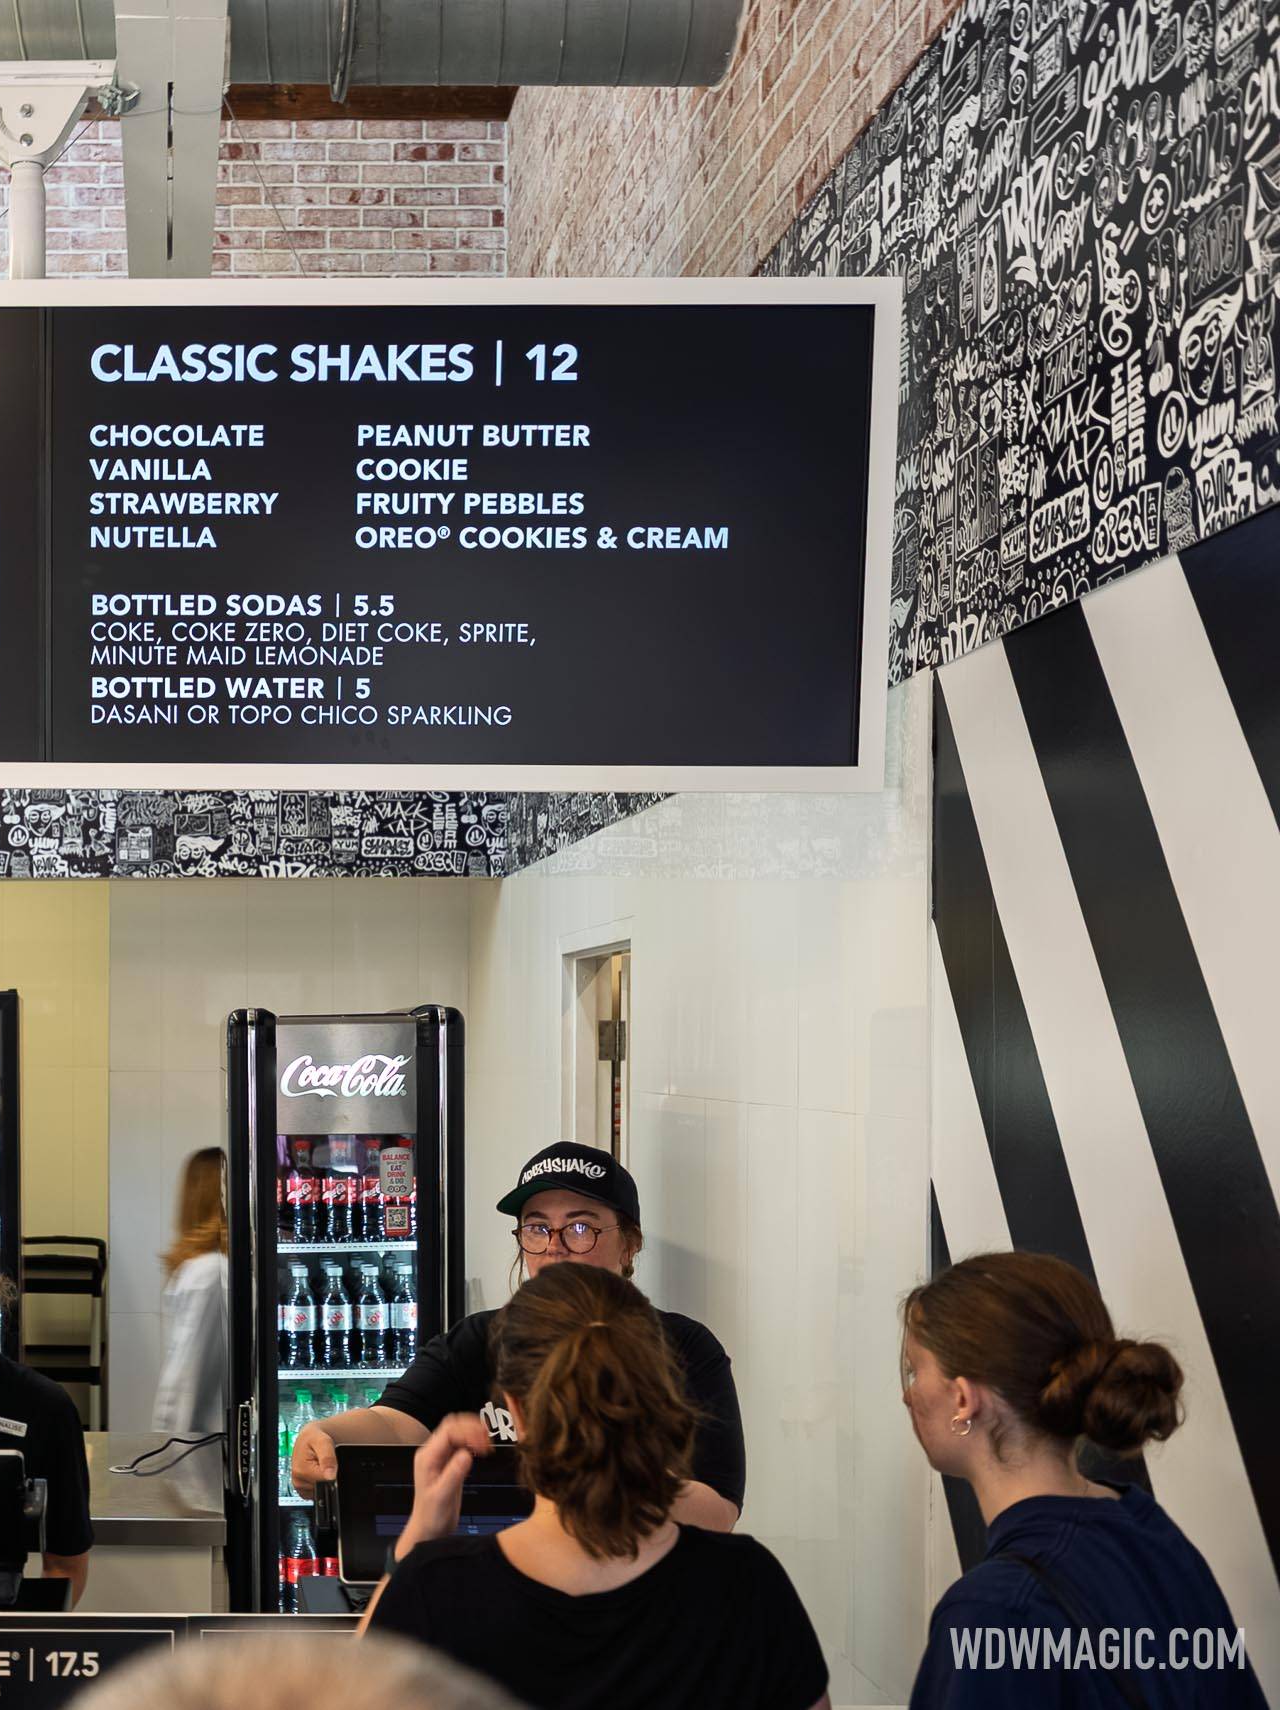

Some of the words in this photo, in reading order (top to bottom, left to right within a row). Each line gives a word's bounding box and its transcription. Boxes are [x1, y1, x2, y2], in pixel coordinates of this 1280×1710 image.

[90, 343, 278, 382] CLASSIC
[289, 343, 474, 382] SHAKES
[525, 343, 578, 380] 12
[89, 424, 264, 447] CHOCOLATE
[357, 424, 473, 446] PEANUT
[482, 424, 590, 446] BUTTER
[88, 458, 212, 480] VANILLA
[356, 458, 467, 480] COOKIE
[89, 492, 278, 514] STRAWBERRY
[356, 492, 455, 514] FRUITY
[464, 492, 584, 514] PEBBLES
[90, 526, 216, 548] NUTELLA
[458, 526, 587, 548] COOKIES
[596, 526, 617, 548] &
[626, 526, 728, 549] CREAM
[92, 594, 216, 615] BOTTLED
[226, 594, 321, 616] SODAS
[353, 594, 394, 616] 5.5
[90, 622, 162, 646] COKE,
[171, 622, 236, 642] COKE
[244, 622, 312, 646] ZERO,
[322, 623, 369, 643] DIET
[376, 623, 449, 647] COKE,
[458, 623, 537, 647] SPRITE,
[90, 646, 176, 665] MINUTE
[186, 646, 246, 664] MAID
[255, 646, 383, 665] LEMONADE
[91, 676, 216, 698] BOTTLED
[224, 677, 324, 698] WATER
[355, 678, 370, 699] 5
[91, 704, 177, 723] DASANI
[187, 704, 219, 723] OR
[228, 704, 292, 724] TOPO
[300, 705, 378, 724] CHICO
[387, 705, 512, 725] SPARKLING
[45, 1651, 100, 1677] 17.5
